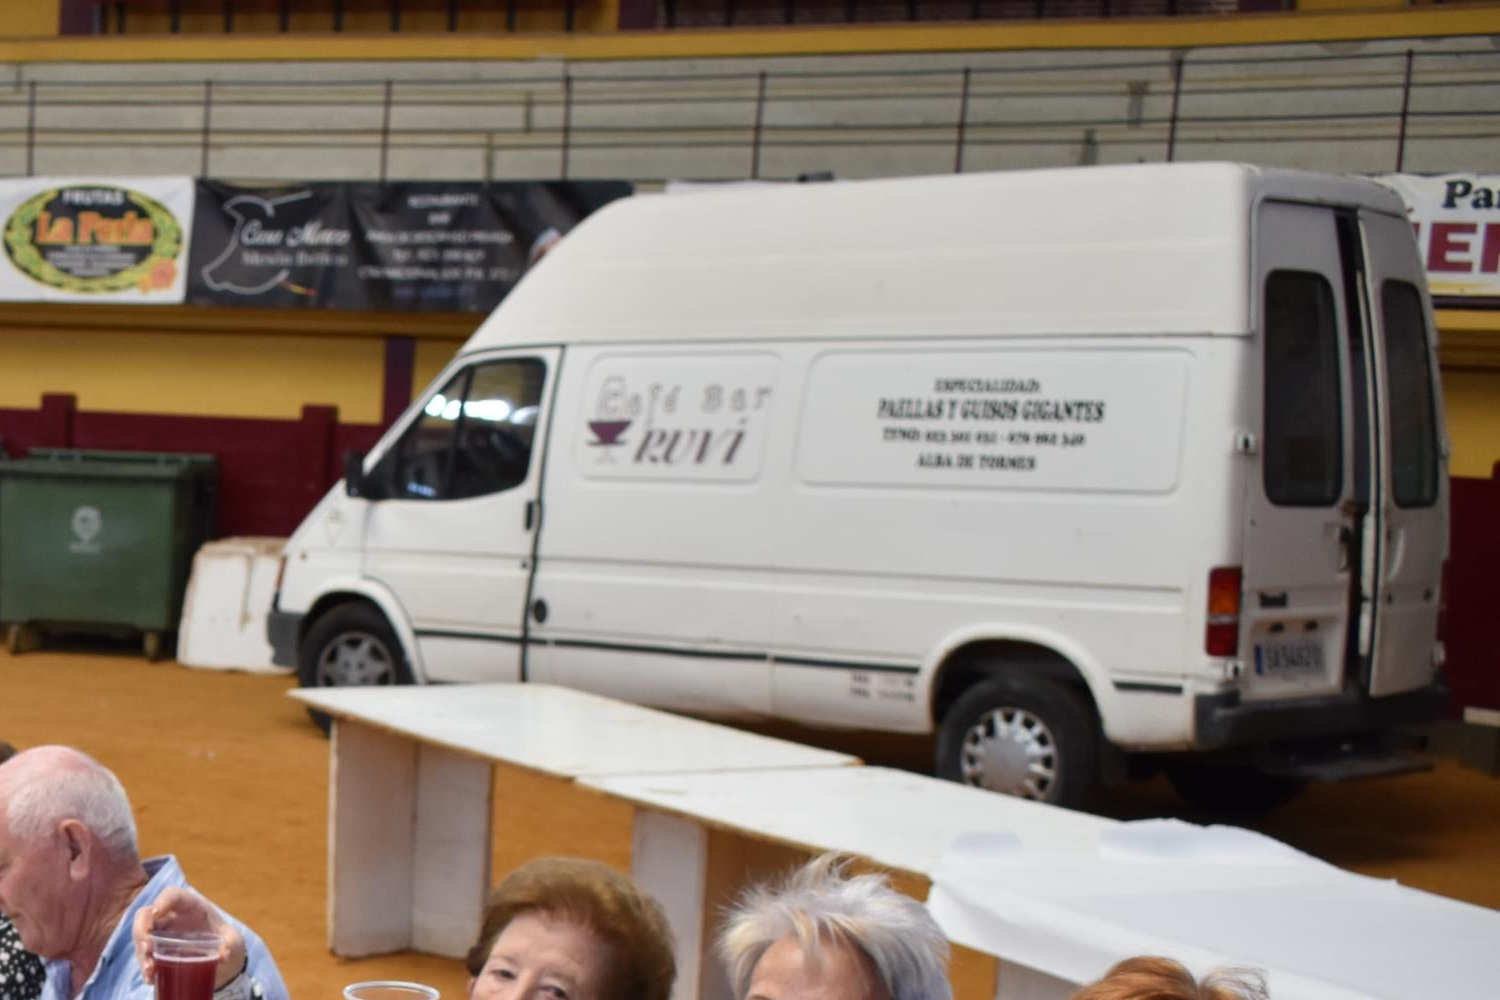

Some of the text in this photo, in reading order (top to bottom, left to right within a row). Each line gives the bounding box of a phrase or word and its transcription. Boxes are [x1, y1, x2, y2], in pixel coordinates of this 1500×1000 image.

[877, 398, 1105, 422] PAELLAS Y GUISOS GIGANTES
[917, 454, 952, 469] ALBA
[957, 455, 973, 469] DE
